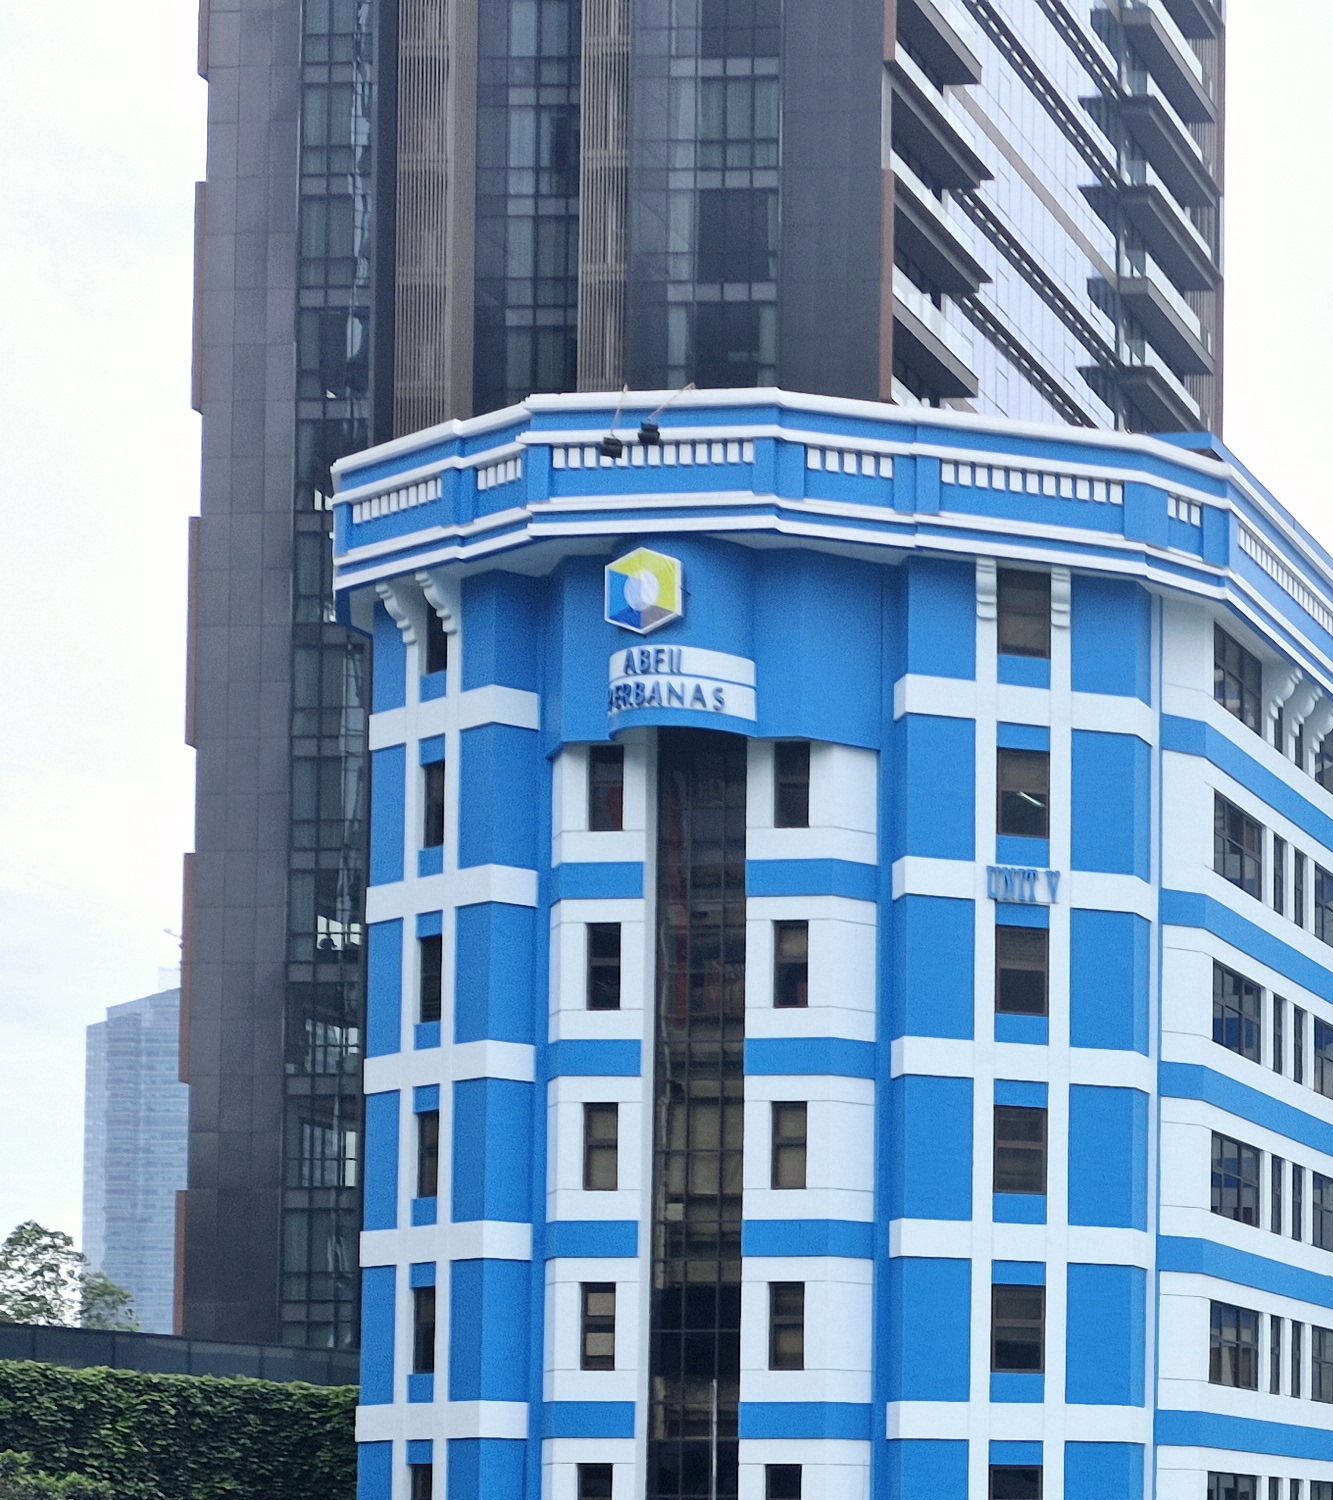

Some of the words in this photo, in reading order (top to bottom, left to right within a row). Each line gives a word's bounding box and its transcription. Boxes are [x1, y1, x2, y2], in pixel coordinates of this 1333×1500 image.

[624, 648, 683, 675] ABFII
[986, 865, 1038, 902] UNIT
[1045, 870, 1061, 904] V
